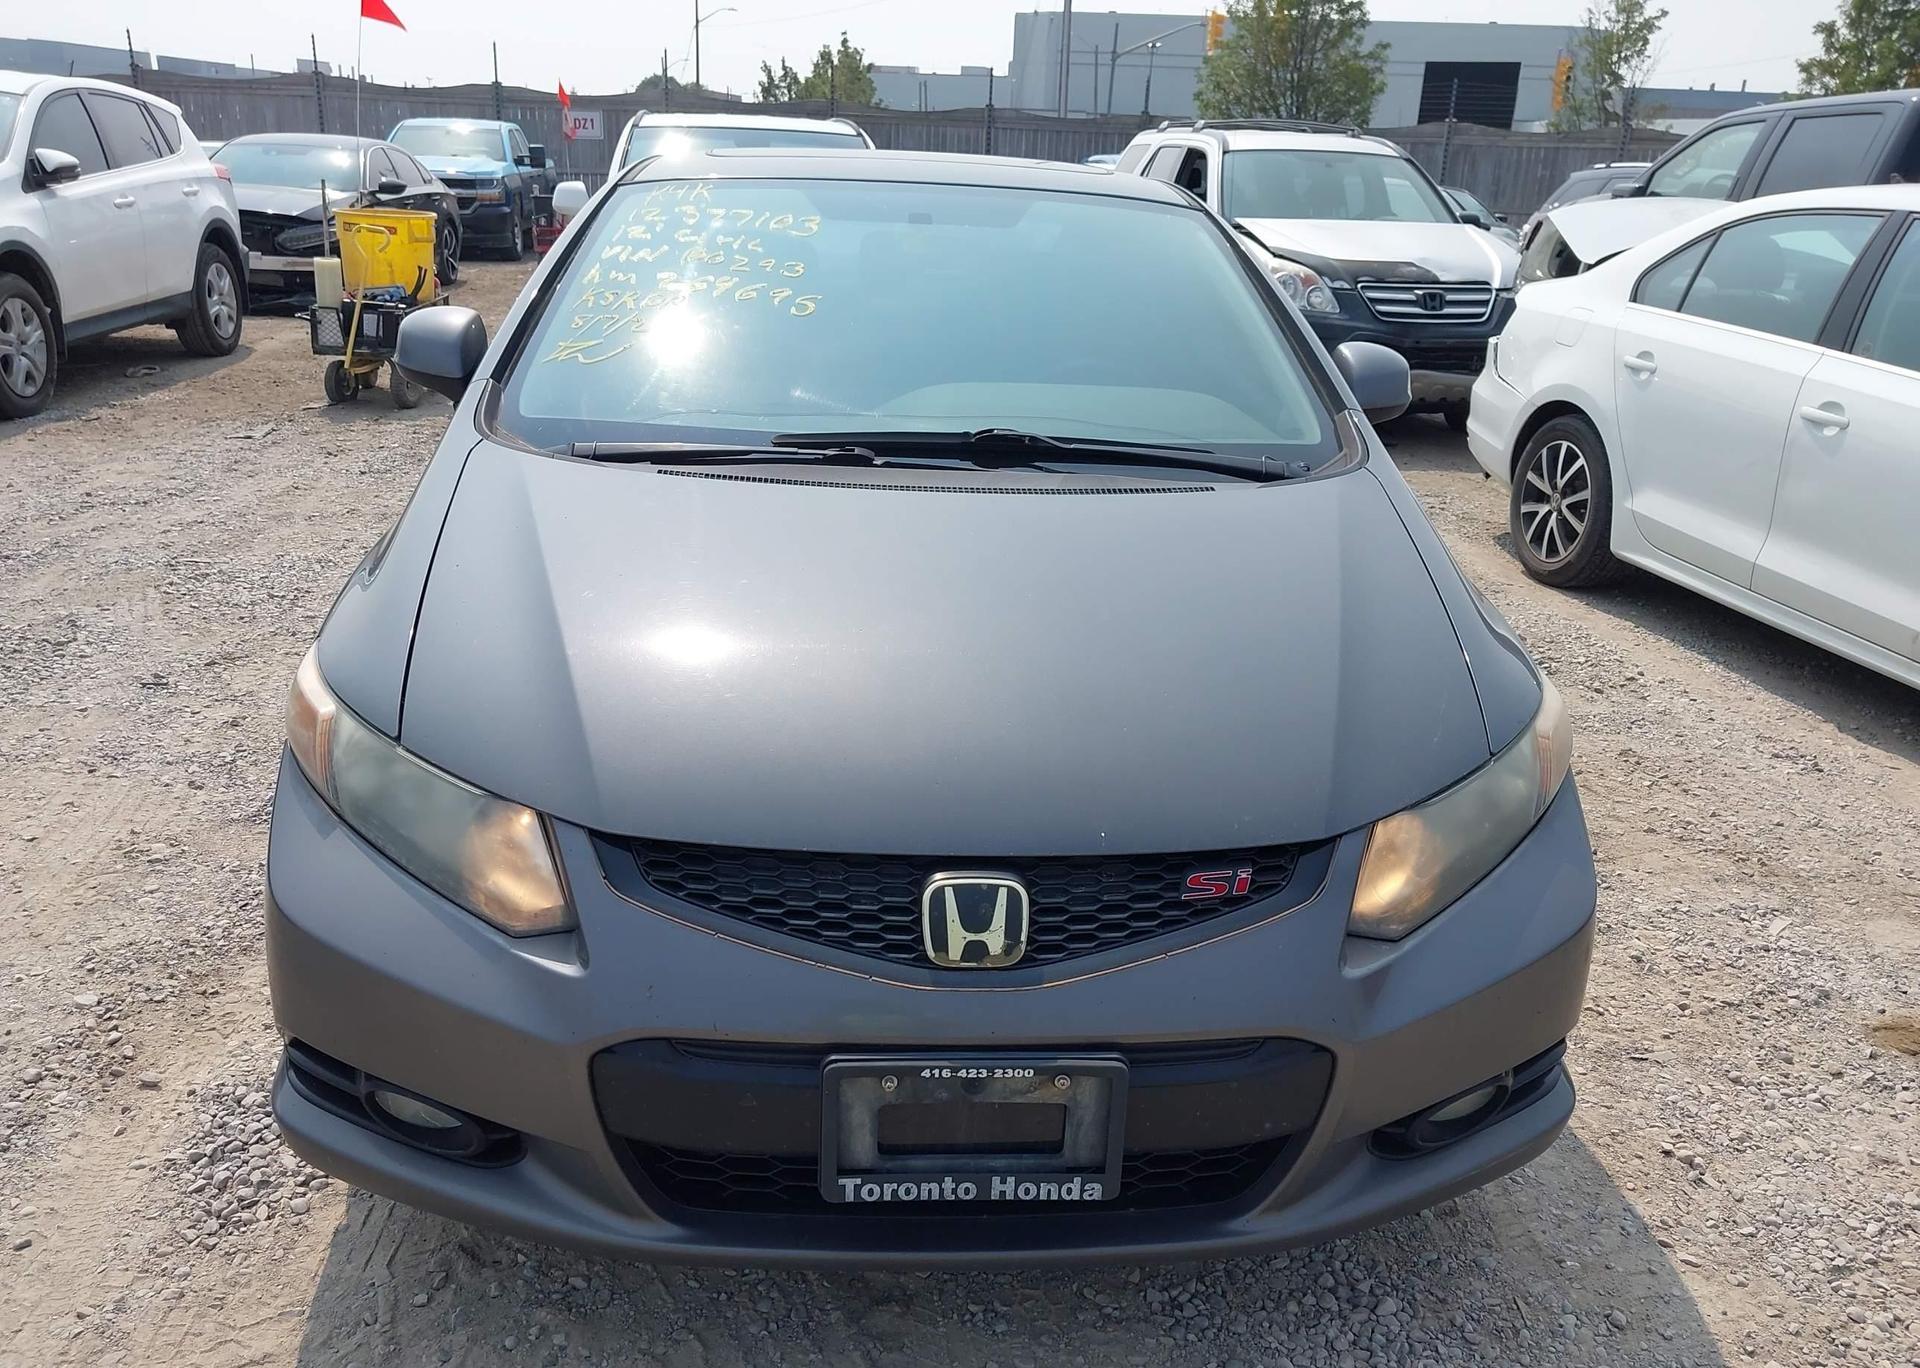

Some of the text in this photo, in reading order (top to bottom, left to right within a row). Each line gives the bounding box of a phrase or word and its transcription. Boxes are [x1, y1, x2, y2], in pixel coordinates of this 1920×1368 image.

[1181, 868, 1252, 900] Si
[920, 1068, 1034, 1079] 416-423-2300
[838, 1176, 1103, 1202] Toronto Honda
